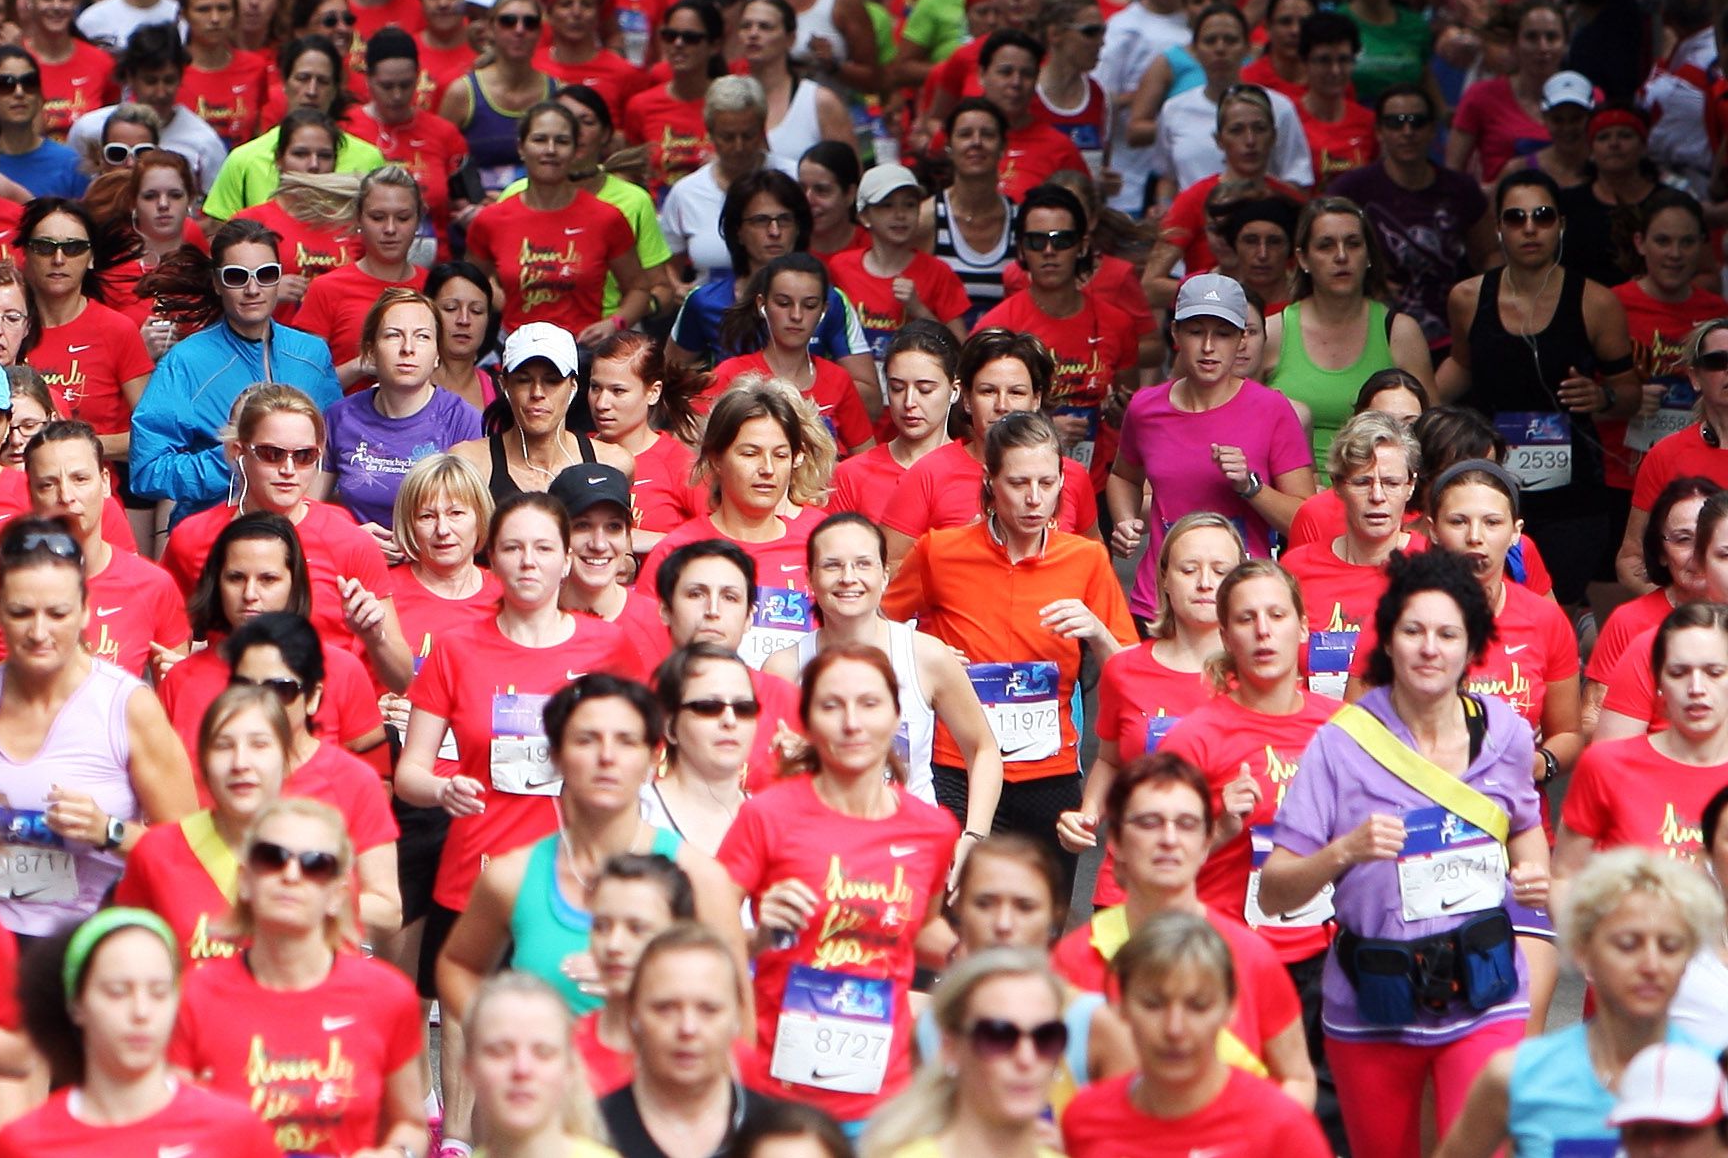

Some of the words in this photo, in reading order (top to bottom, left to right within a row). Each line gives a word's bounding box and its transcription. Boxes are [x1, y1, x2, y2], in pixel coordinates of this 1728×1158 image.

[997, 709, 1057, 732] 11972
[1433, 853, 1500, 883] 25747
[813, 1025, 885, 1063] 8727
